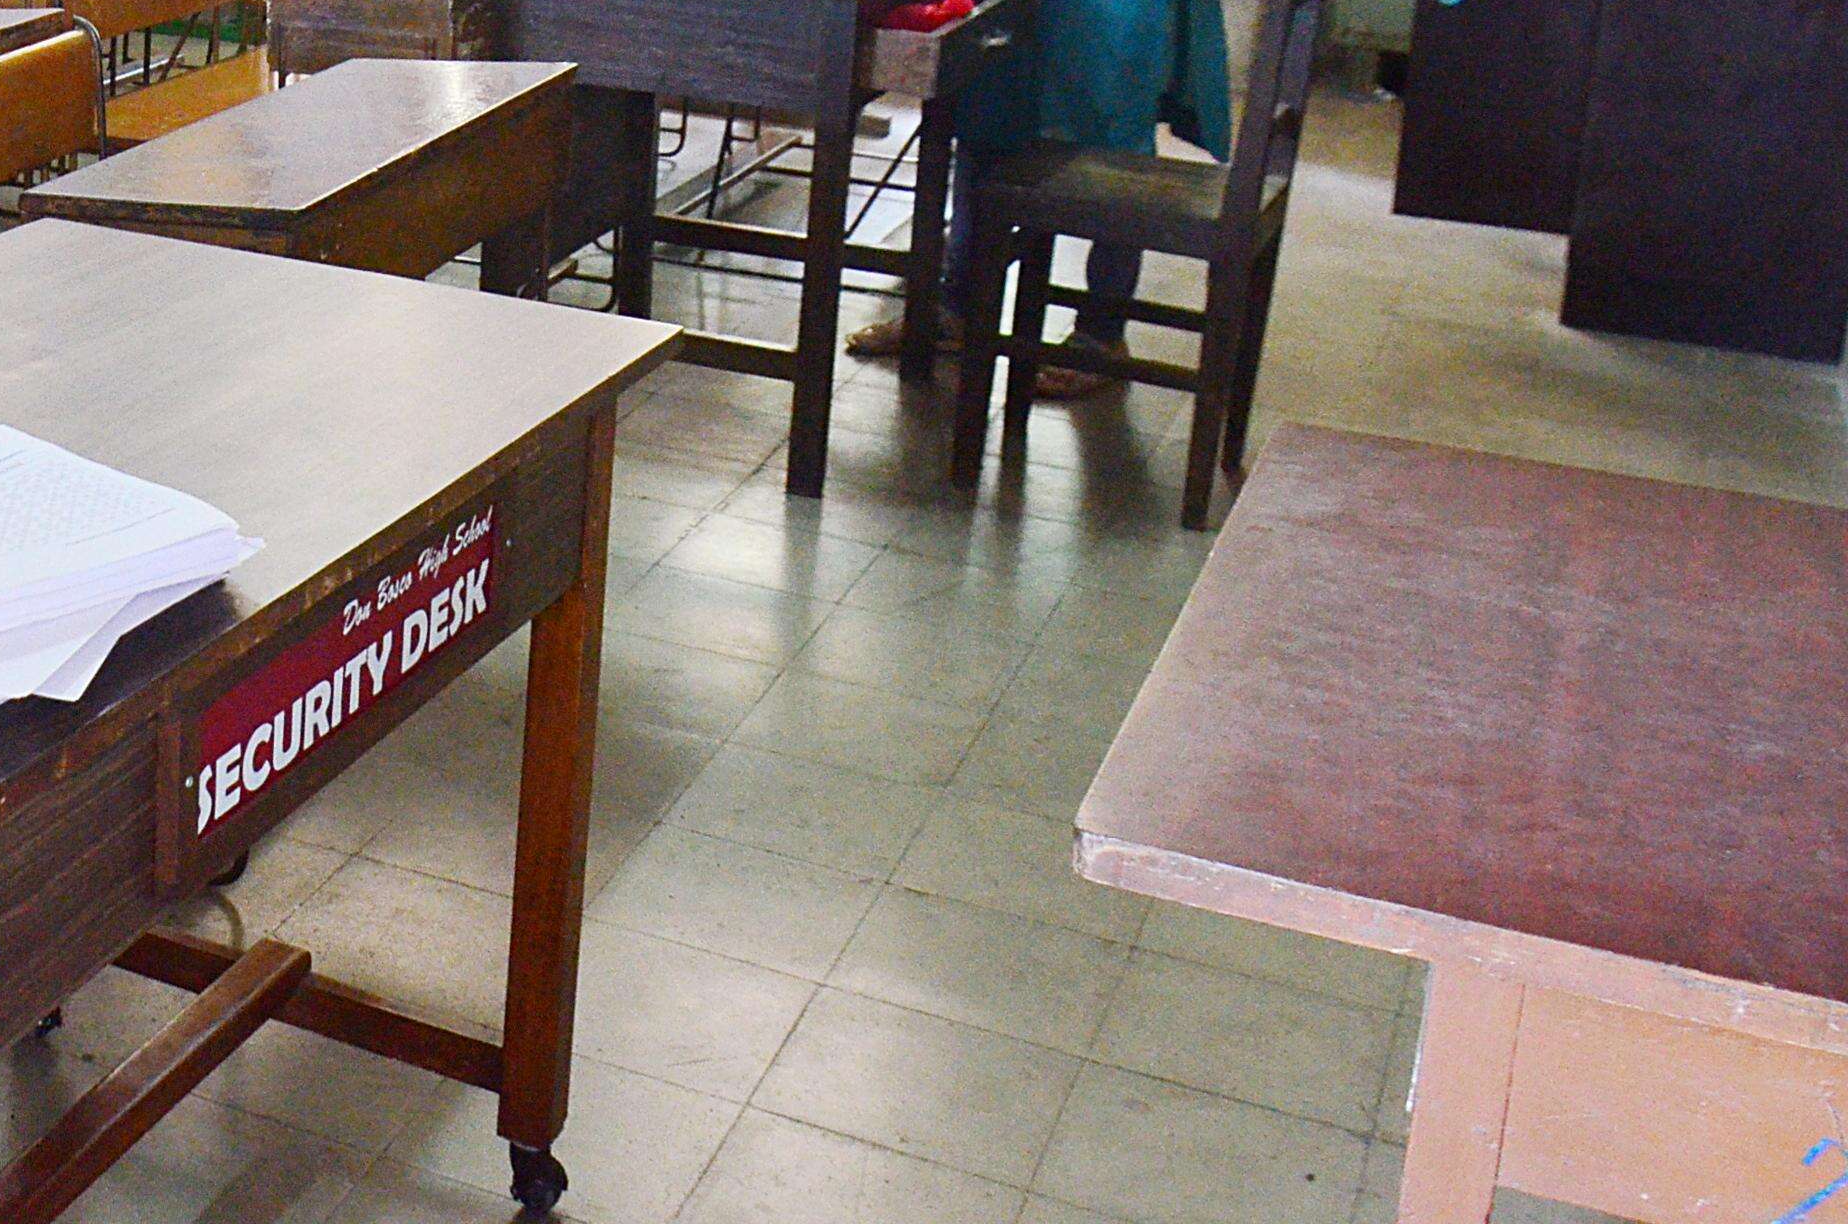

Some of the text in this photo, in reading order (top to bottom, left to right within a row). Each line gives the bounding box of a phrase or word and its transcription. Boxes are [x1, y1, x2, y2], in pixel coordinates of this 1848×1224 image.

[342, 505, 493, 636] Don Bosco High School
[198, 558, 489, 834] SECURITY DESK
